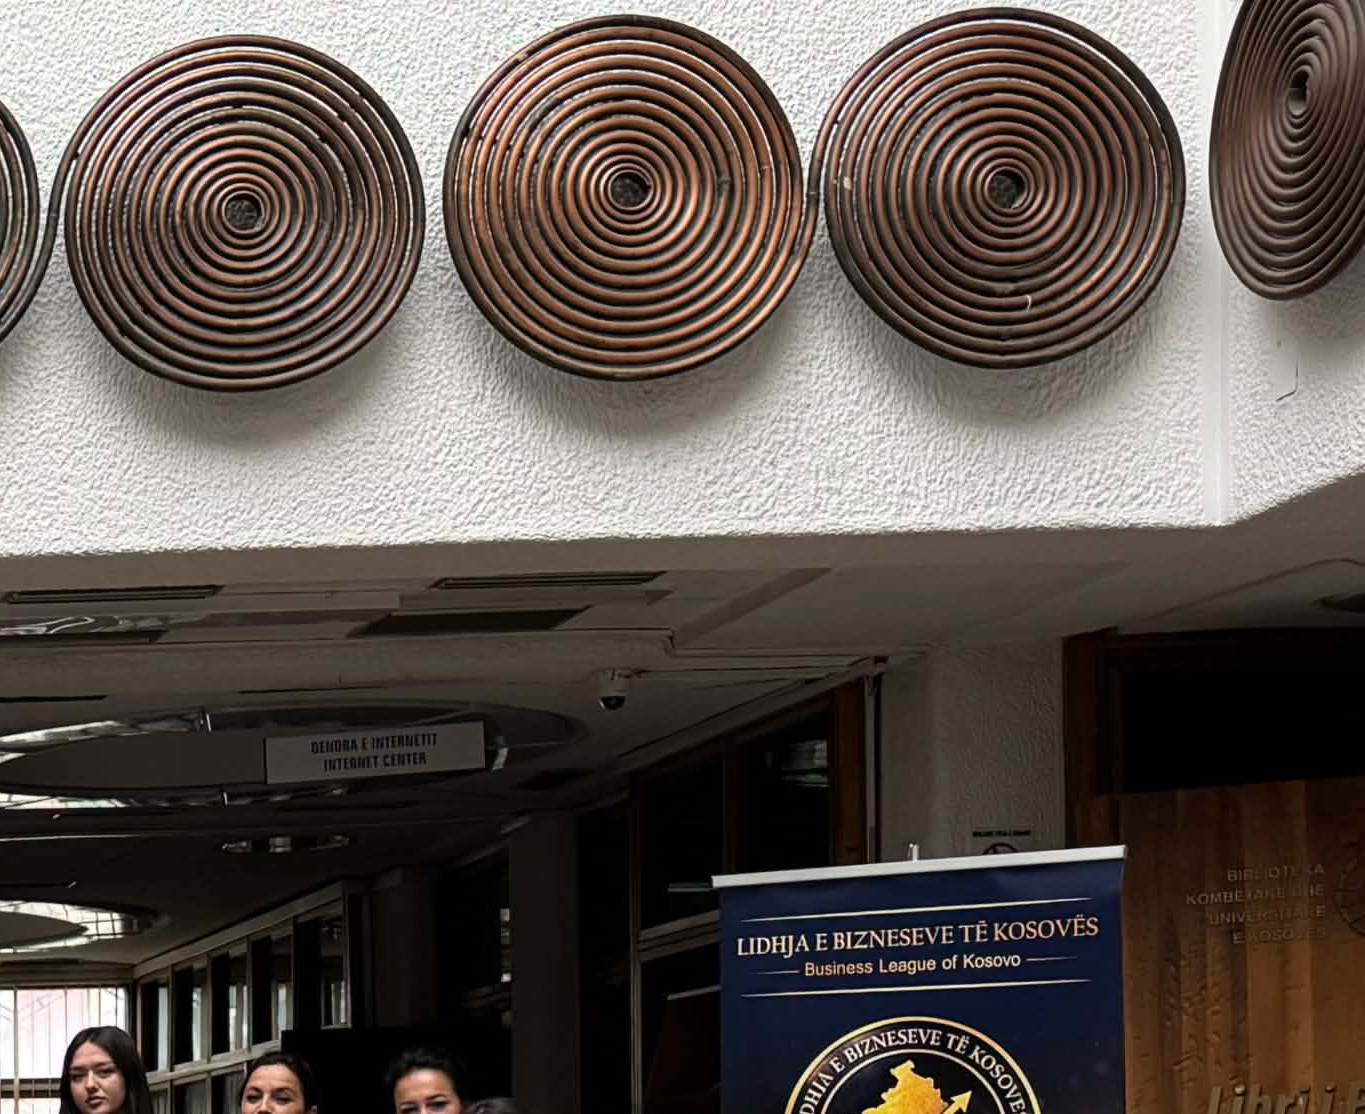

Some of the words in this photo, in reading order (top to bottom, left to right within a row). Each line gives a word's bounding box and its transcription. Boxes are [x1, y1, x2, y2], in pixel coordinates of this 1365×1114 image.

[324, 755, 378, 772] INTERNET
[383, 751, 427, 767] CENTER
[737, 933, 810, 959] LIDHJA
[815, 932, 829, 951] E
[832, 925, 955, 951] BIZNESEVE
[958, 920, 988, 944] TË
[993, 913, 1100, 942] KOSOVËS
[804, 960, 874, 977] Business
[878, 957, 937, 976] League
[941, 954, 959, 970] of
[963, 953, 1022, 969] Kosovo
[829, 1056, 846, 1073] E
[843, 1028, 943, 1064] BIZNESEVE
